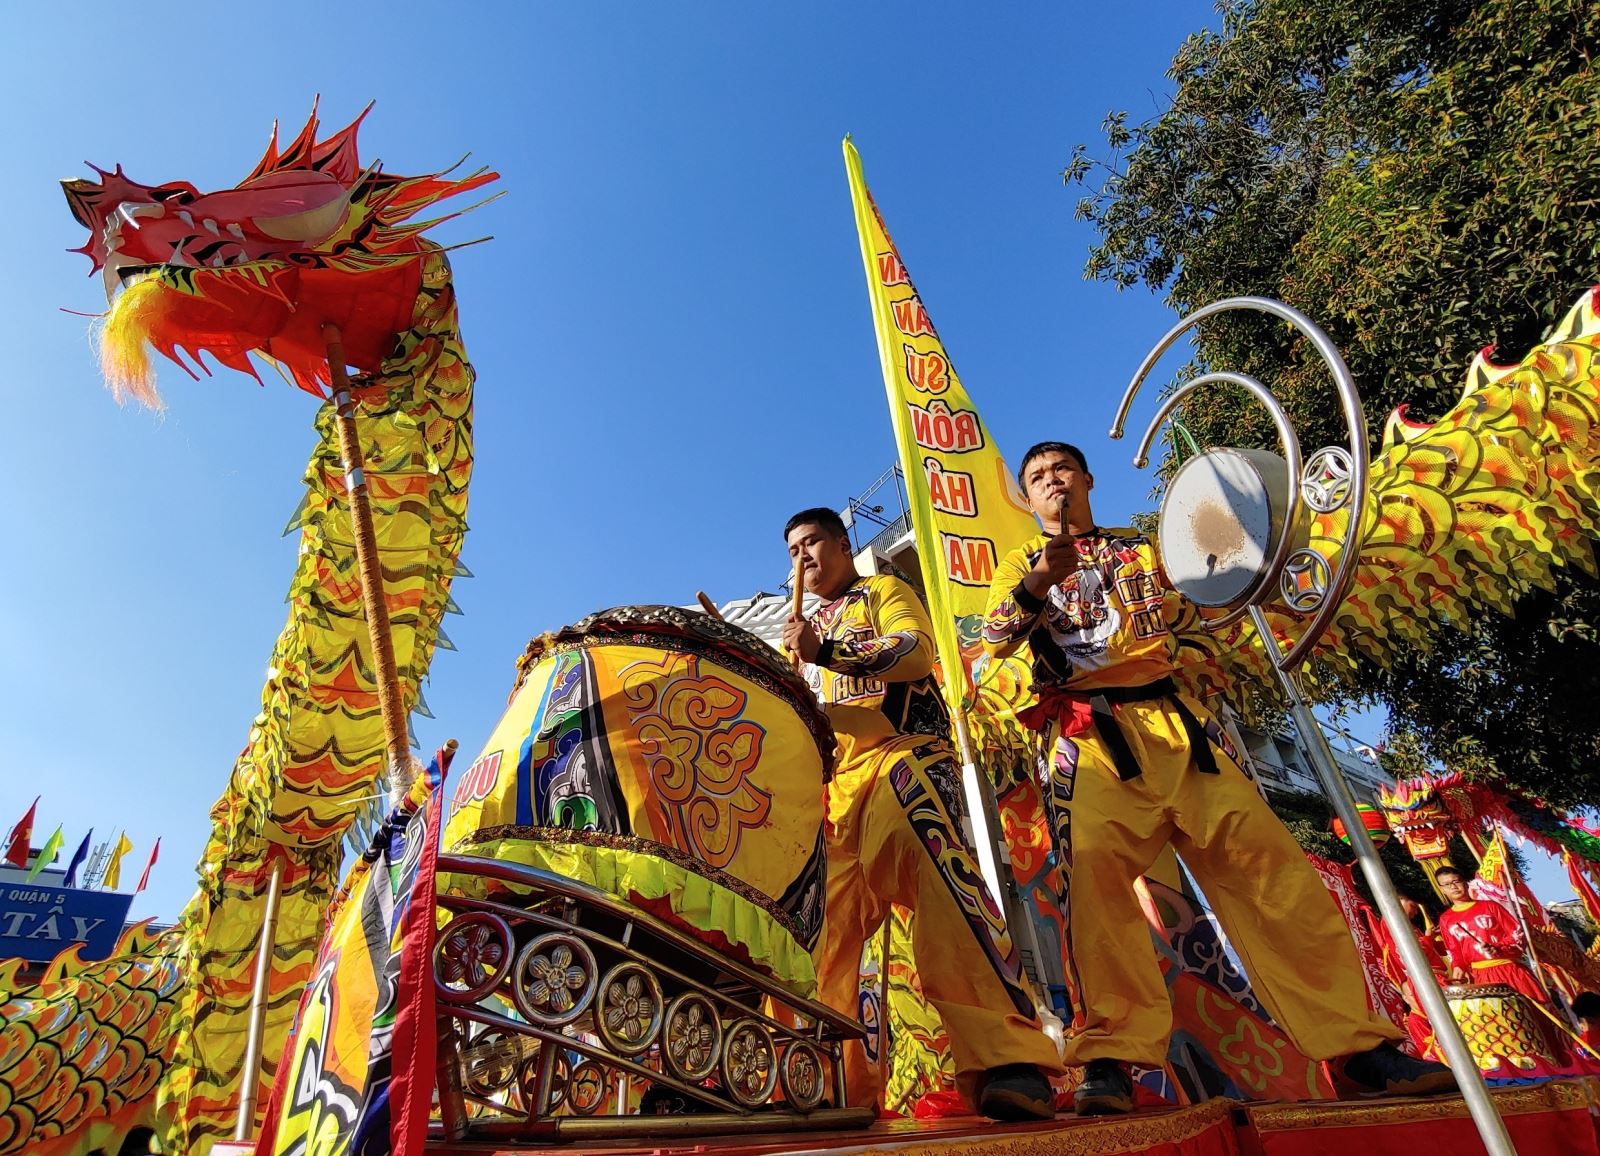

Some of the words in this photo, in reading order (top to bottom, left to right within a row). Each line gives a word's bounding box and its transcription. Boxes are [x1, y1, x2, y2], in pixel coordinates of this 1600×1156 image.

[8, 889, 50, 904] QUẬN
[55, 894, 66, 904] 5
[1, 906, 105, 942] TÂY
